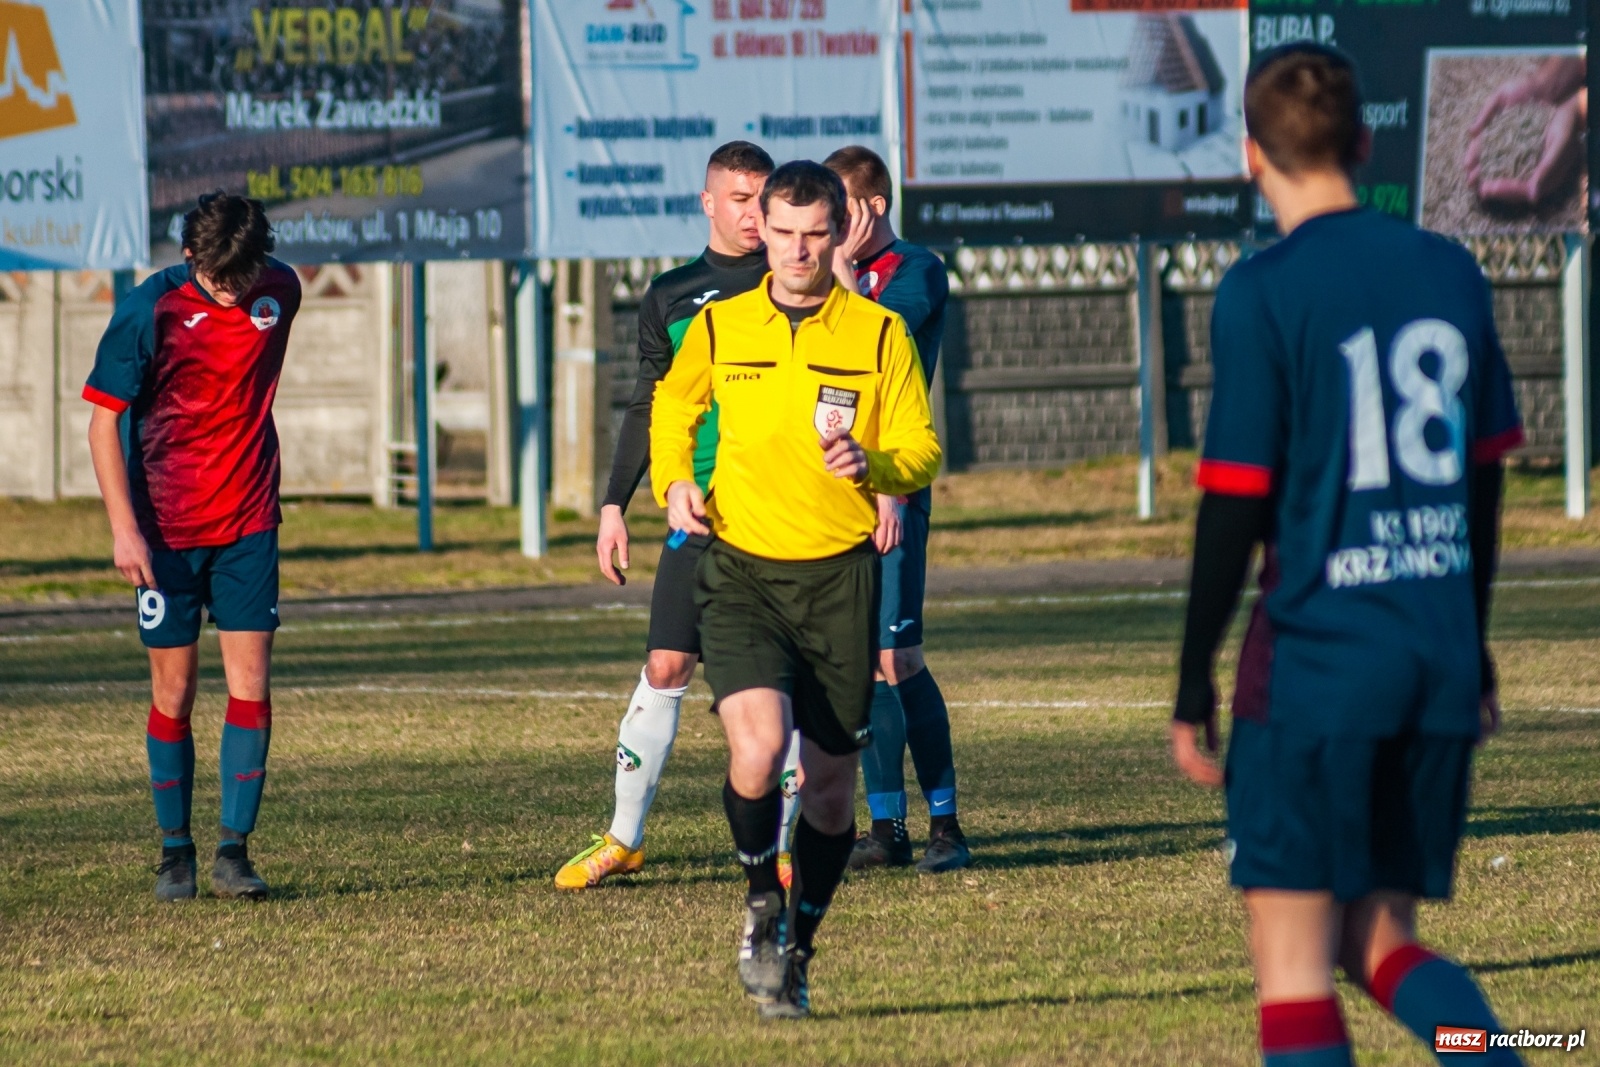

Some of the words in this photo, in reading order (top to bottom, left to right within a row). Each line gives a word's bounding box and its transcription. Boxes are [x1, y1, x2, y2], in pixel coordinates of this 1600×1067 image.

[226, 90, 310, 129] Marek
[315, 90, 441, 129] Zawadzki
[0, 155, 83, 202] orski
[273, 210, 358, 247] worków,
[361, 209, 391, 242] ul.
[396, 211, 408, 241] 1
[414, 208, 470, 247] Maja
[475, 209, 502, 240] 10
[1338, 318, 1469, 491] 18
[1370, 509, 1405, 546] KS
